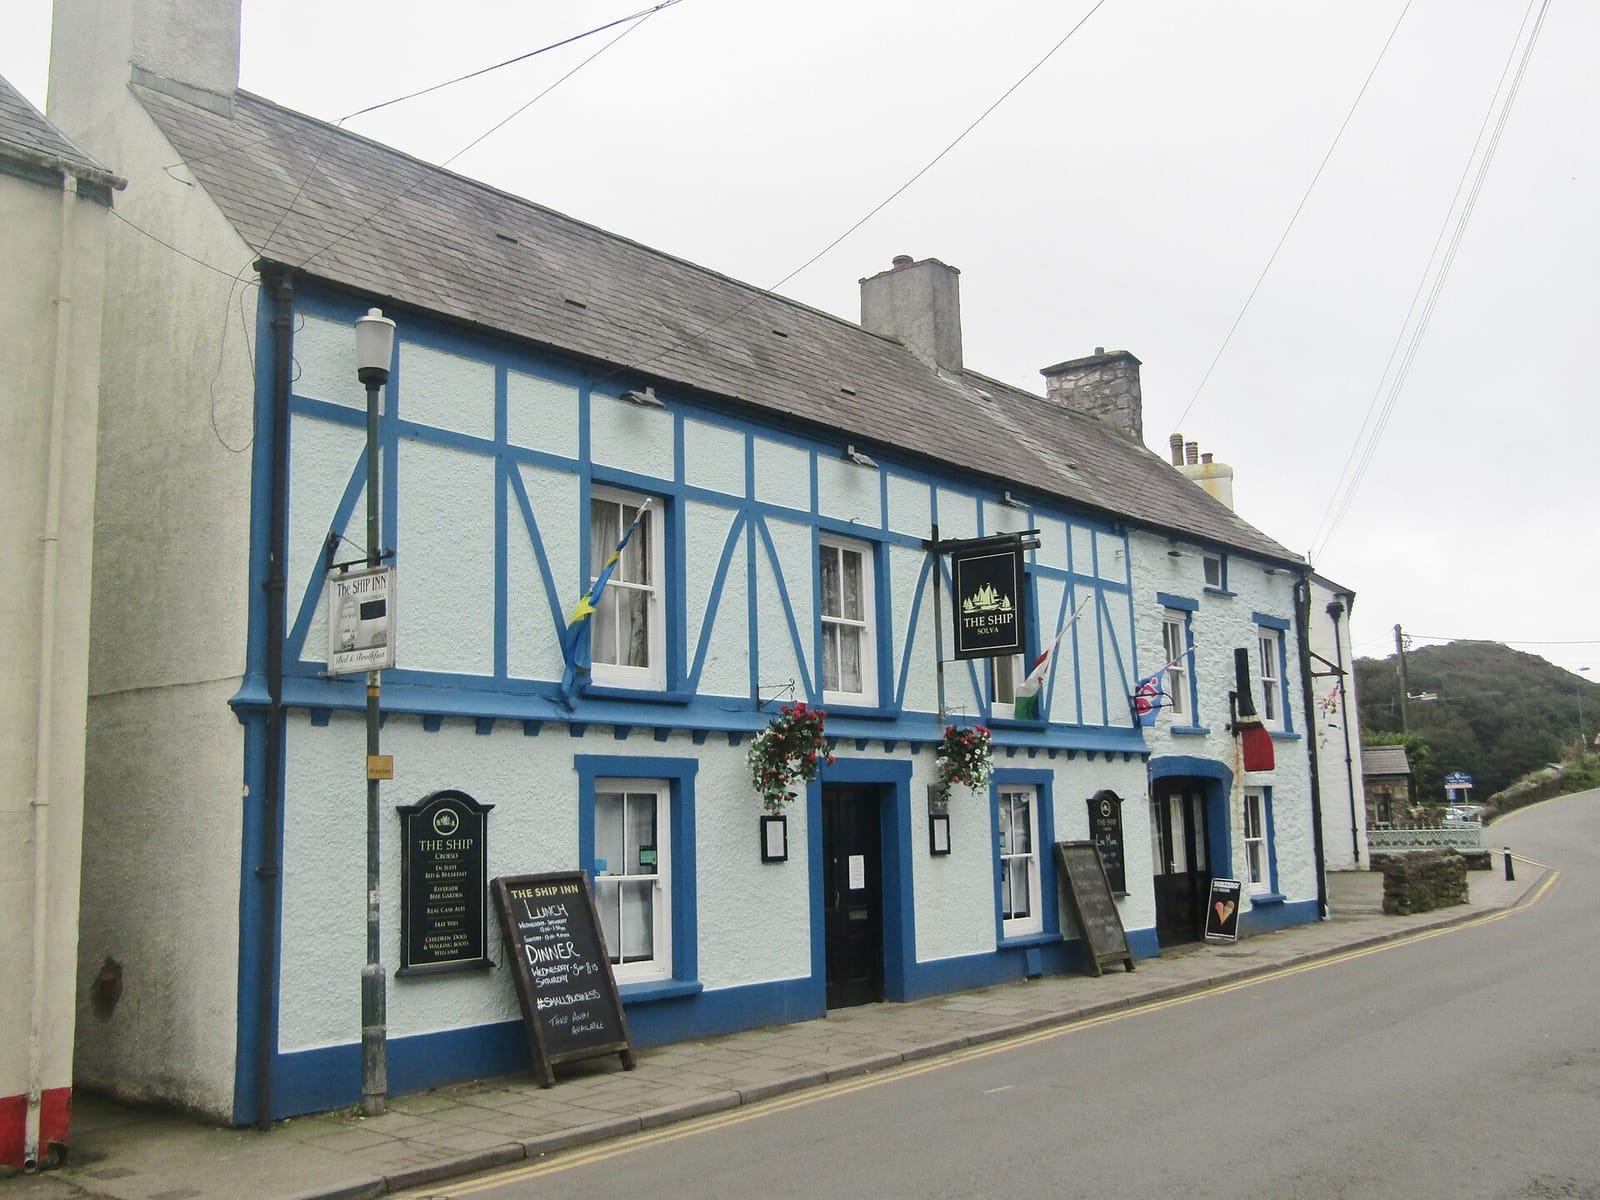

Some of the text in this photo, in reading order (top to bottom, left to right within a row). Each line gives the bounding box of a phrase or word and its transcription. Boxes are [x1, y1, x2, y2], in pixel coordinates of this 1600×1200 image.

[338, 575, 387, 597] The SHIP INN
[964, 613, 1014, 628] THE SHIP
[977, 626, 999, 635] SOLVA
[419, 838, 473, 851] THE SHIP
[511, 884, 579, 899] THE SHIP INN
[524, 899, 569, 919] LUNCH
[525, 941, 580, 964] DINNER
[535, 974, 568, 988] SATURDAY
[548, 1013, 569, 1027] TAKE
